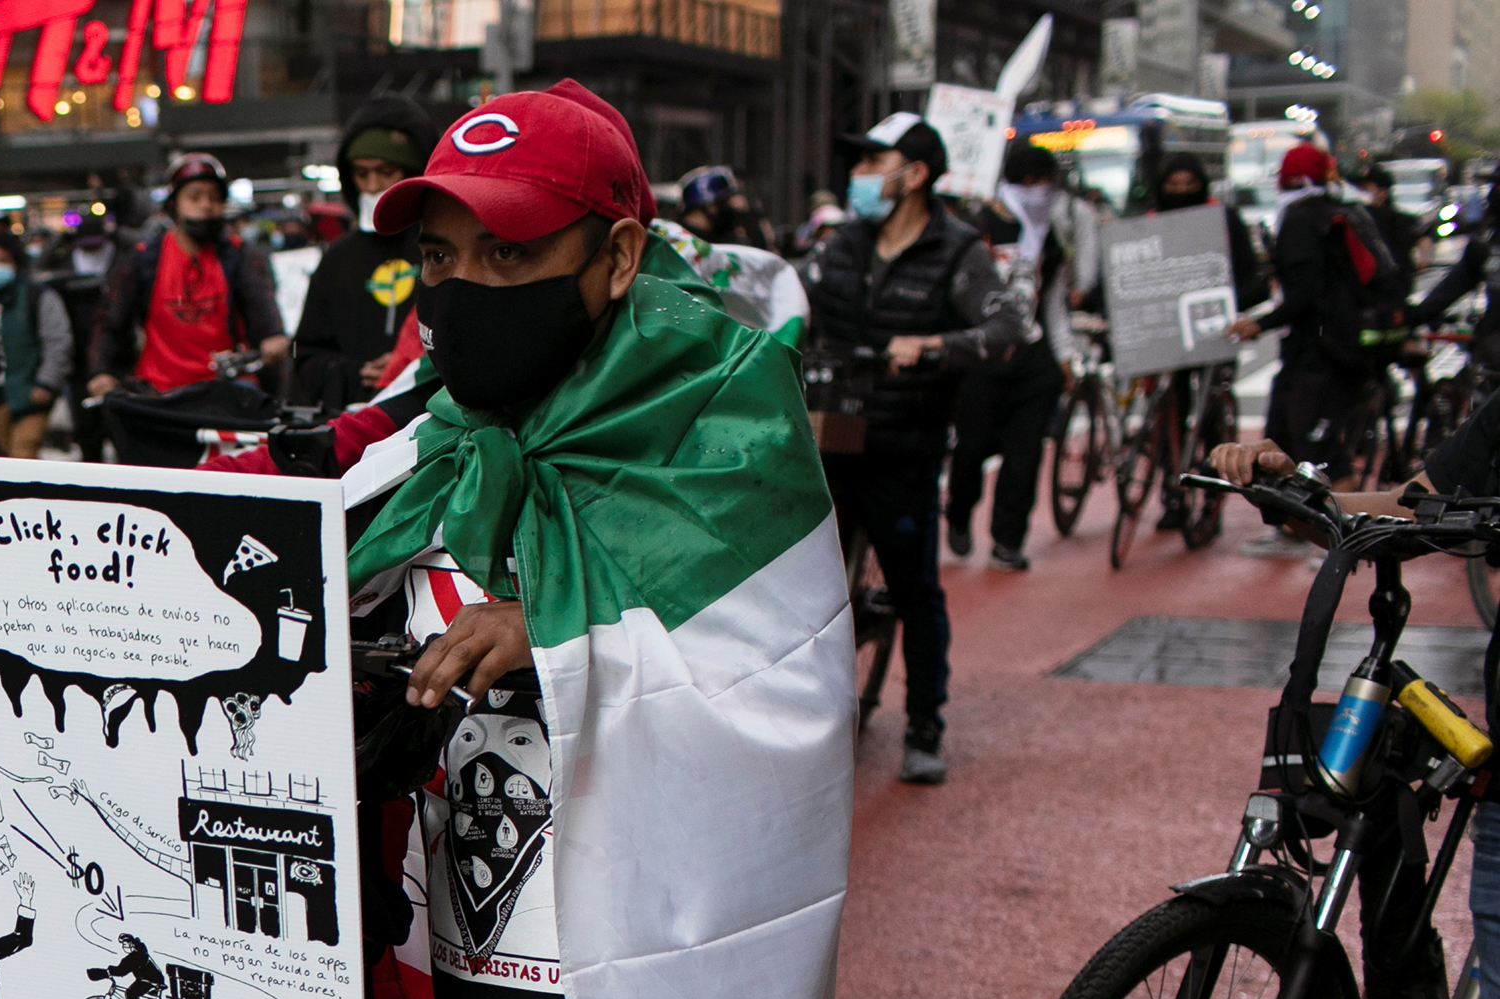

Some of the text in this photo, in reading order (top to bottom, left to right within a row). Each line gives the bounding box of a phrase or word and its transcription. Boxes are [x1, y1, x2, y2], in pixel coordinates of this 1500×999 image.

[96, 513, 171, 557] click
[48, 548, 135, 589] food!
[2, 599, 10, 616] y
[56, 597, 130, 616] aplicaciones
[138, 603, 155, 618] de
[213, 614, 231, 626] no
[27, 642, 48, 657] que
[54, 644, 66, 655] su
[72, 646, 116, 663] negocio
[122, 650, 143, 662] sea
[61, 623, 78, 635] los
[88, 624, 162, 645] trabajadores
[178, 636, 200, 654] que
[207, 634, 241, 654] hacen
[99, 791, 130, 819] Cargo
[131, 814, 145, 831] de
[189, 808, 323, 848] Restaurant
[65, 845, 105, 896] $0
[173, 927, 191, 939] La
[264, 943, 282, 958] de
[288, 949, 308, 962] los
[317, 955, 348, 972] apps
[192, 946, 210, 957] no
[316, 971, 327, 981] a
[333, 972, 350, 985] los
[432, 941, 447, 963] LOS
